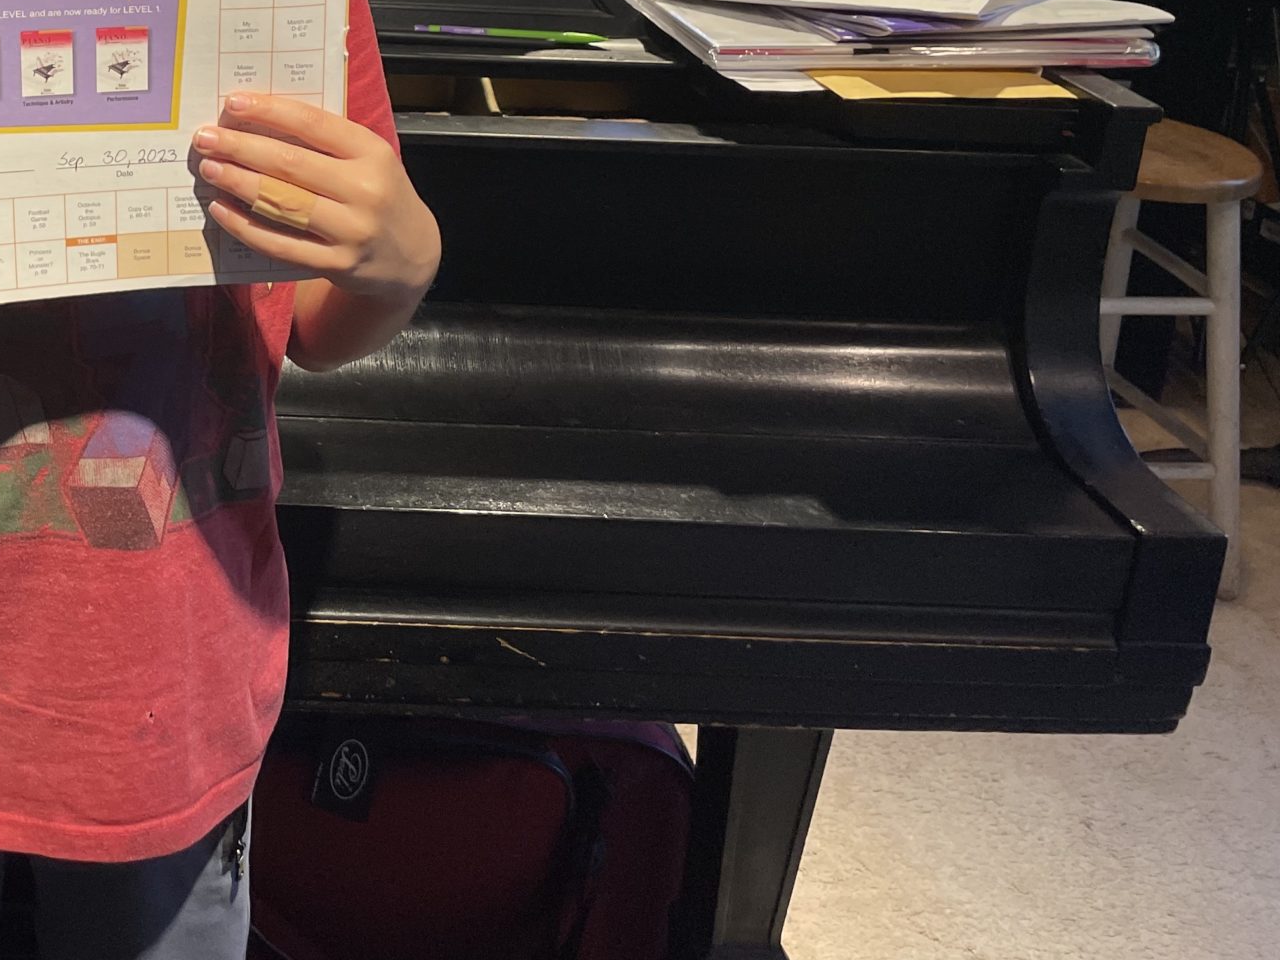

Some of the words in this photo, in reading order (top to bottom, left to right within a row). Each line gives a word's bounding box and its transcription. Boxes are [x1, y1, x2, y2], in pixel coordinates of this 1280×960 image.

[29, 9, 46, 18] and
[48, 9, 61, 17] are
[84, 7, 107, 16] ready
[110, 6, 121, 15] for
[123, 6, 152, 14] LEVEL
[116, 170, 134, 178] Date
